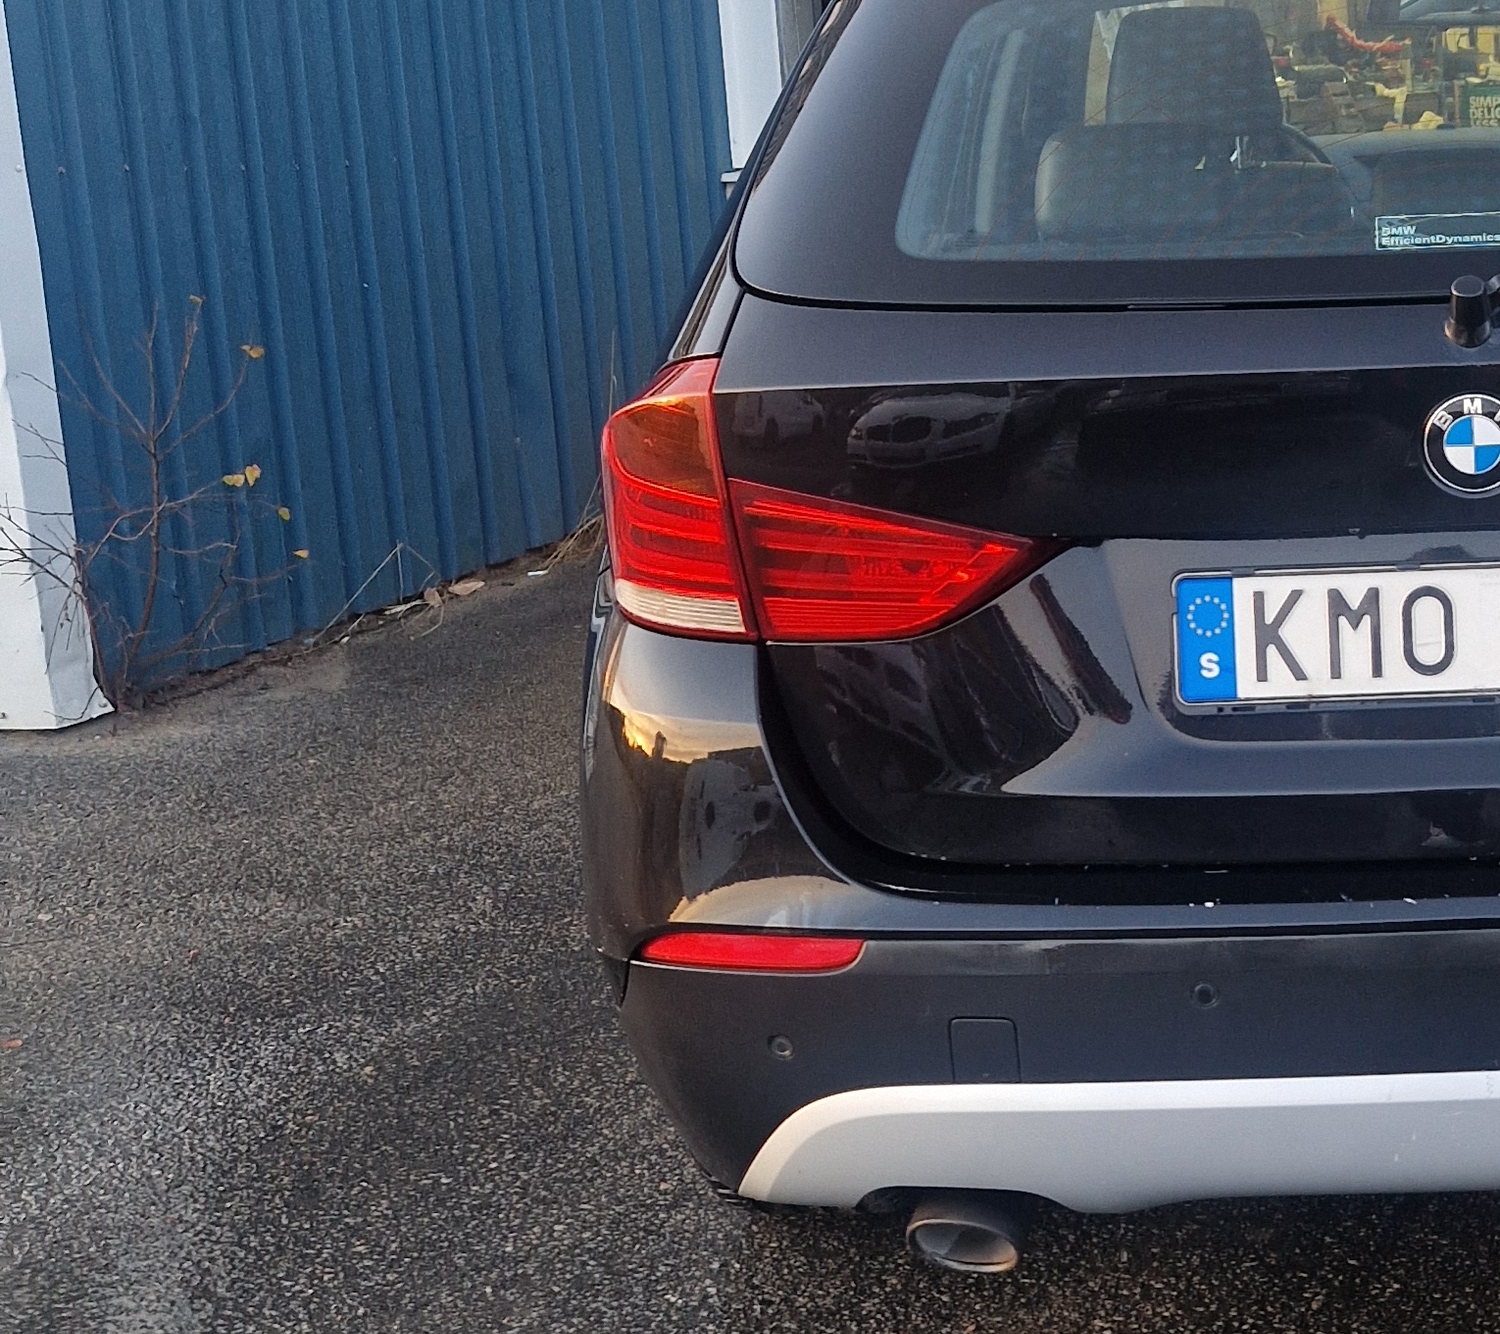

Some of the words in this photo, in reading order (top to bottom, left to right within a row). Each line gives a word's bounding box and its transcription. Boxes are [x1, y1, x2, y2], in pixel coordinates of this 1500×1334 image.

[1381, 225, 1417, 236] BMW
[1252, 584, 1455, 683] KMO
[1199, 653, 1220, 678] S
